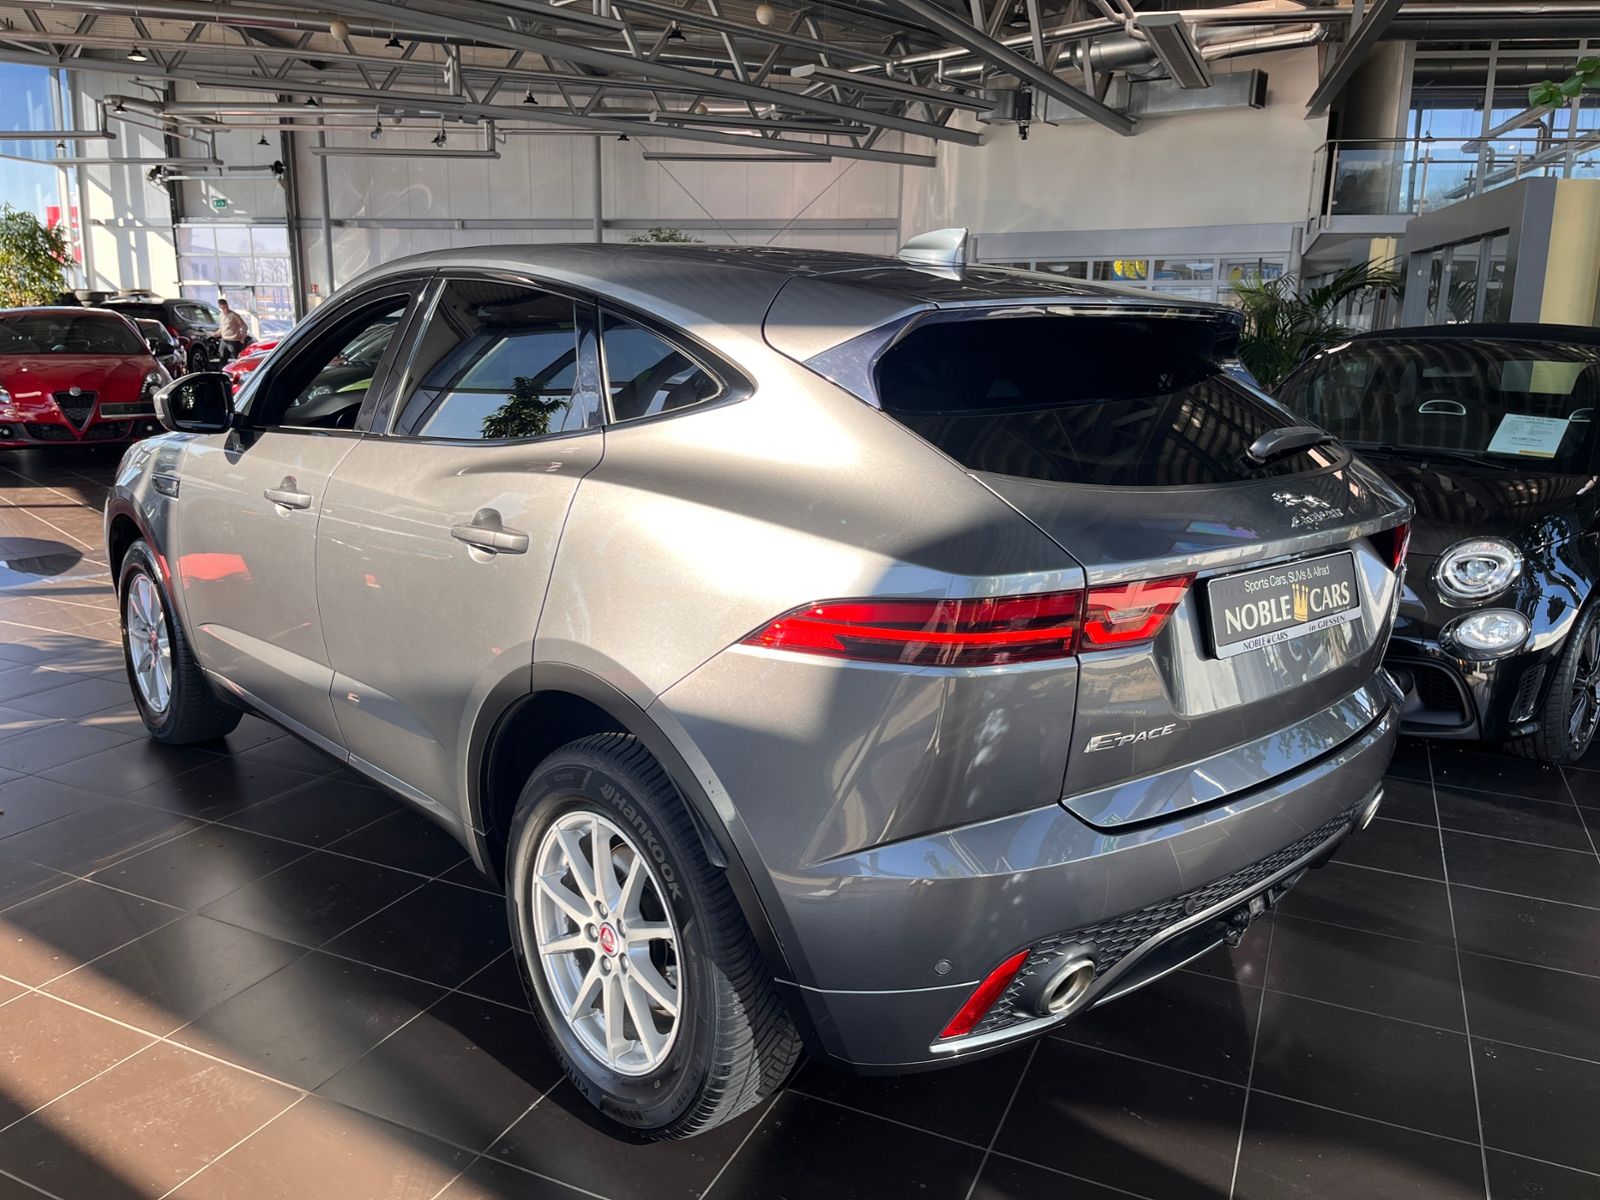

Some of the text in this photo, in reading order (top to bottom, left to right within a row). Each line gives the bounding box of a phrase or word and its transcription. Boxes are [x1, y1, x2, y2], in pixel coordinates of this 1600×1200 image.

[1244, 579, 1270, 594] Sports
[1224, 581, 1350, 635] NOBLE CARS
[1318, 616, 1345, 629] GIESSEN
[1242, 631, 1289, 650] NOBLE CARS
